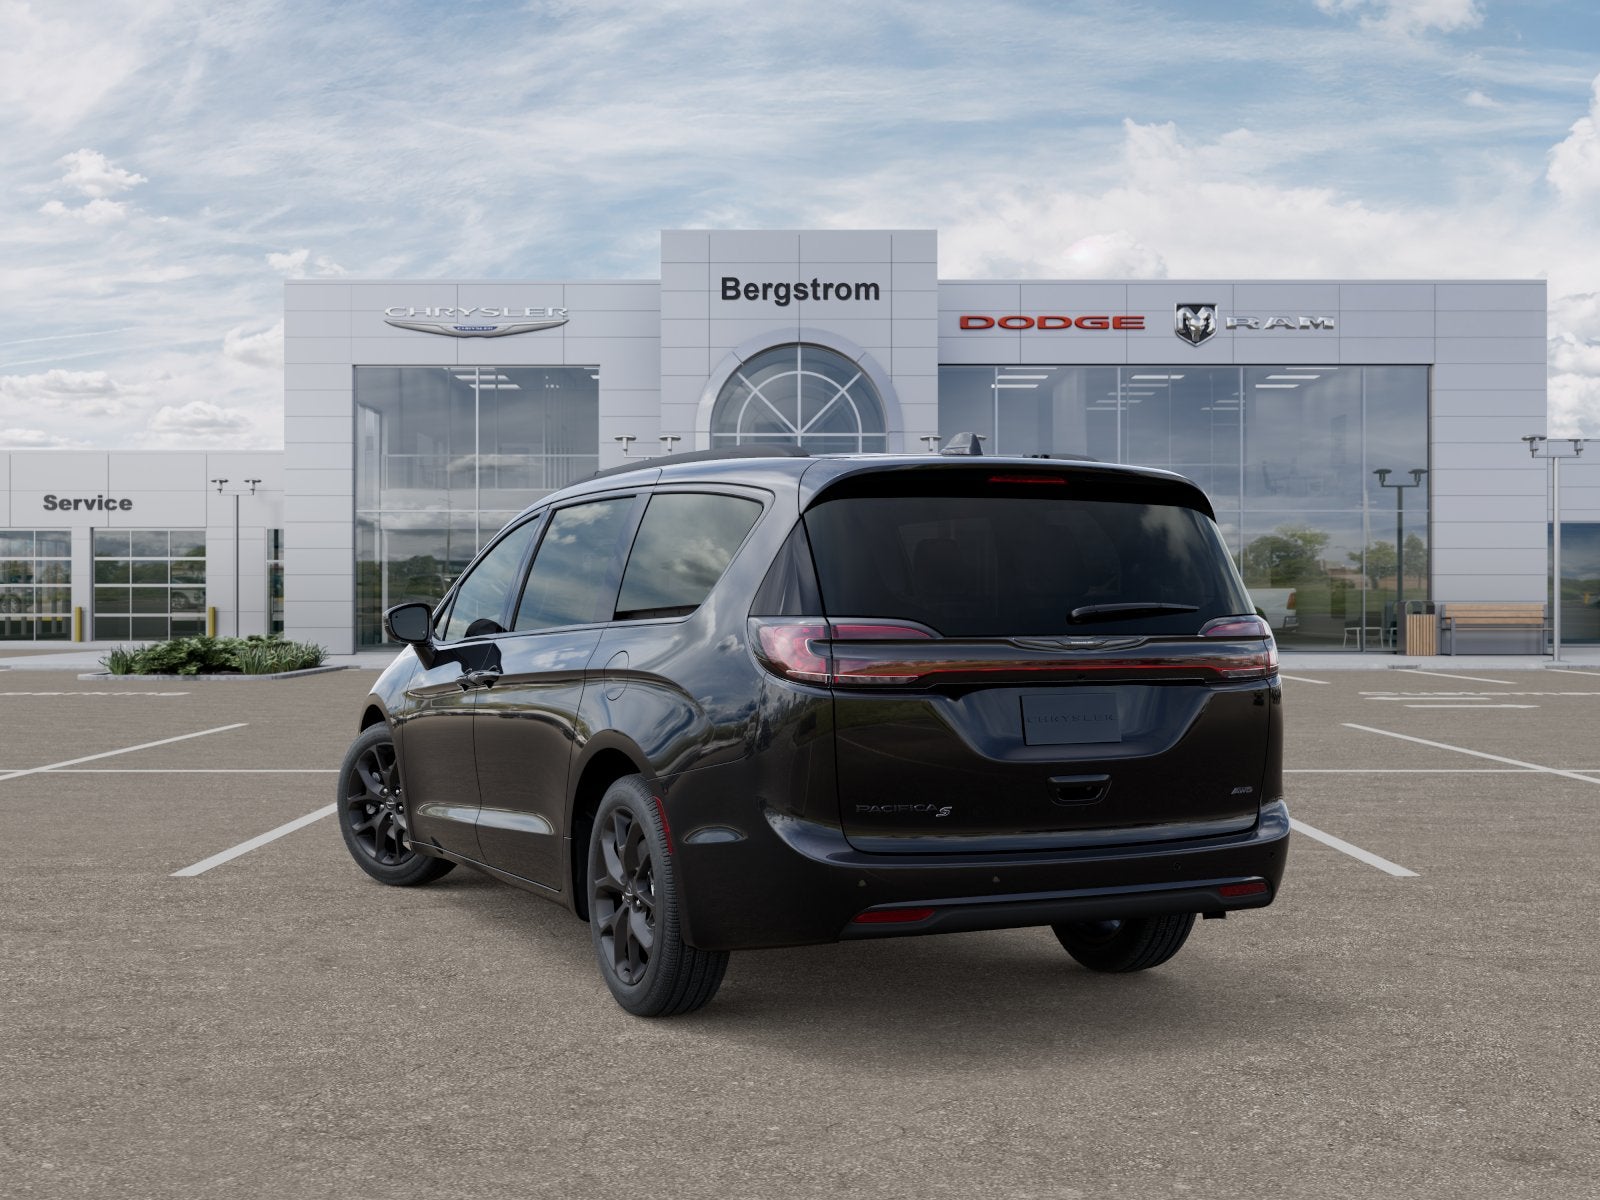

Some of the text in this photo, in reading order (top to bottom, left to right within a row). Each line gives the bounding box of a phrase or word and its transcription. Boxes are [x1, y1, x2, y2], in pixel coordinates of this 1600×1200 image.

[721, 276, 880, 307] Bergstrom
[384, 306, 569, 317] CHRYSLER
[959, 315, 1145, 330] DODGE
[1225, 315, 1335, 330] RAM
[43, 494, 133, 511] Service
[856, 804, 938, 813] PACIFICA
